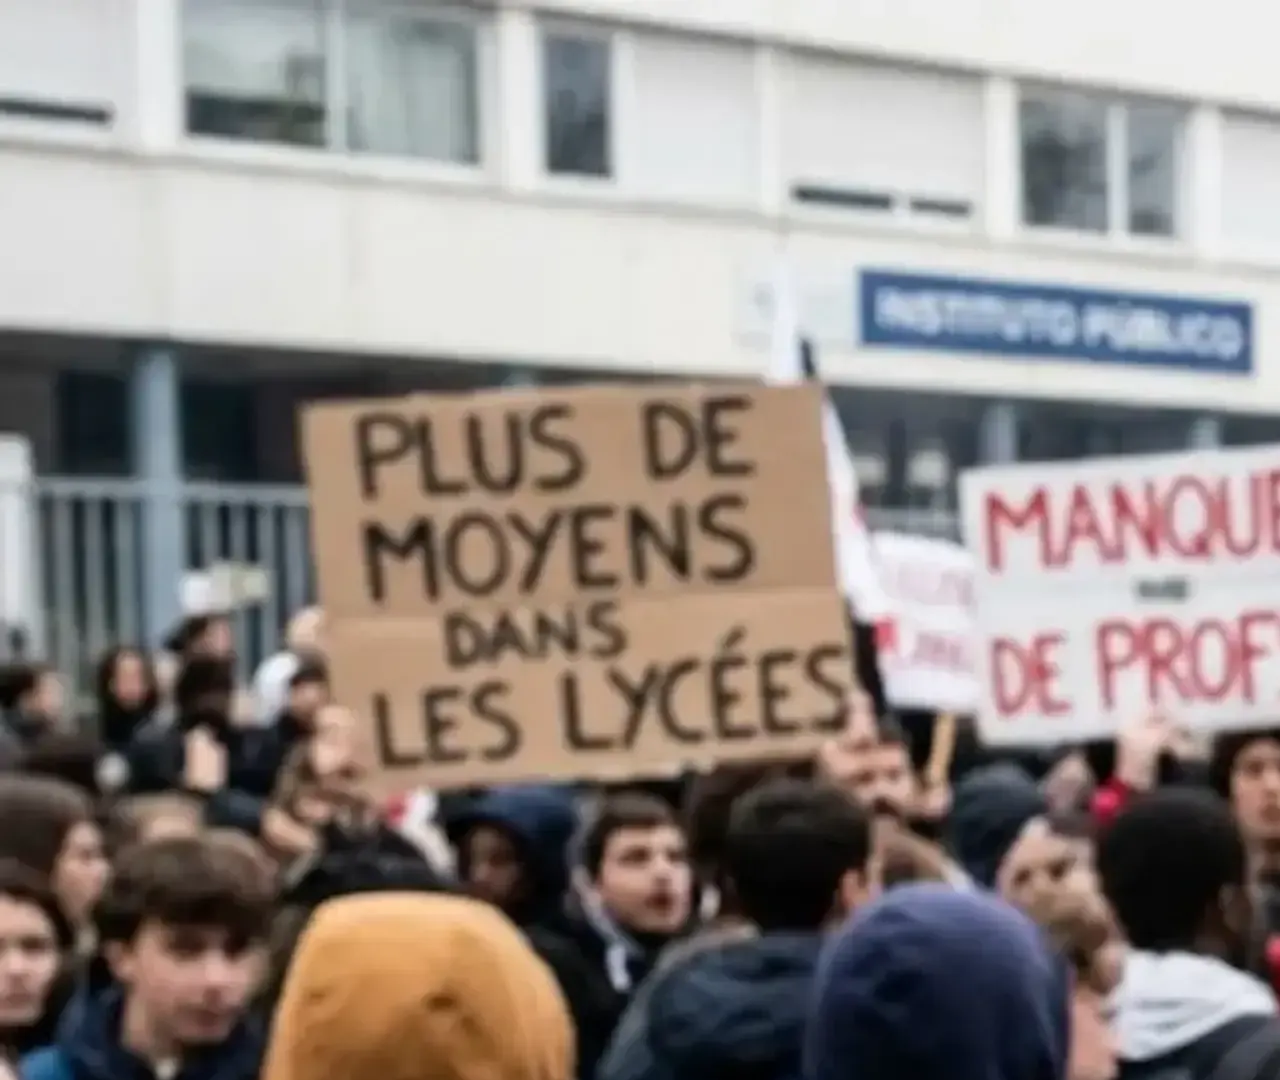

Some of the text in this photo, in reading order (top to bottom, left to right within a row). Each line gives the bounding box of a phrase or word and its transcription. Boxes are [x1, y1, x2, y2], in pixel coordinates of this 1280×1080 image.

[355, 398, 757, 499] PLUS DE
[362, 493, 757, 604] MOYENS
[446, 599, 627, 668] DANS
[990, 631, 1074, 719] DE
[374, 626, 853, 769] LES LYCÉES
